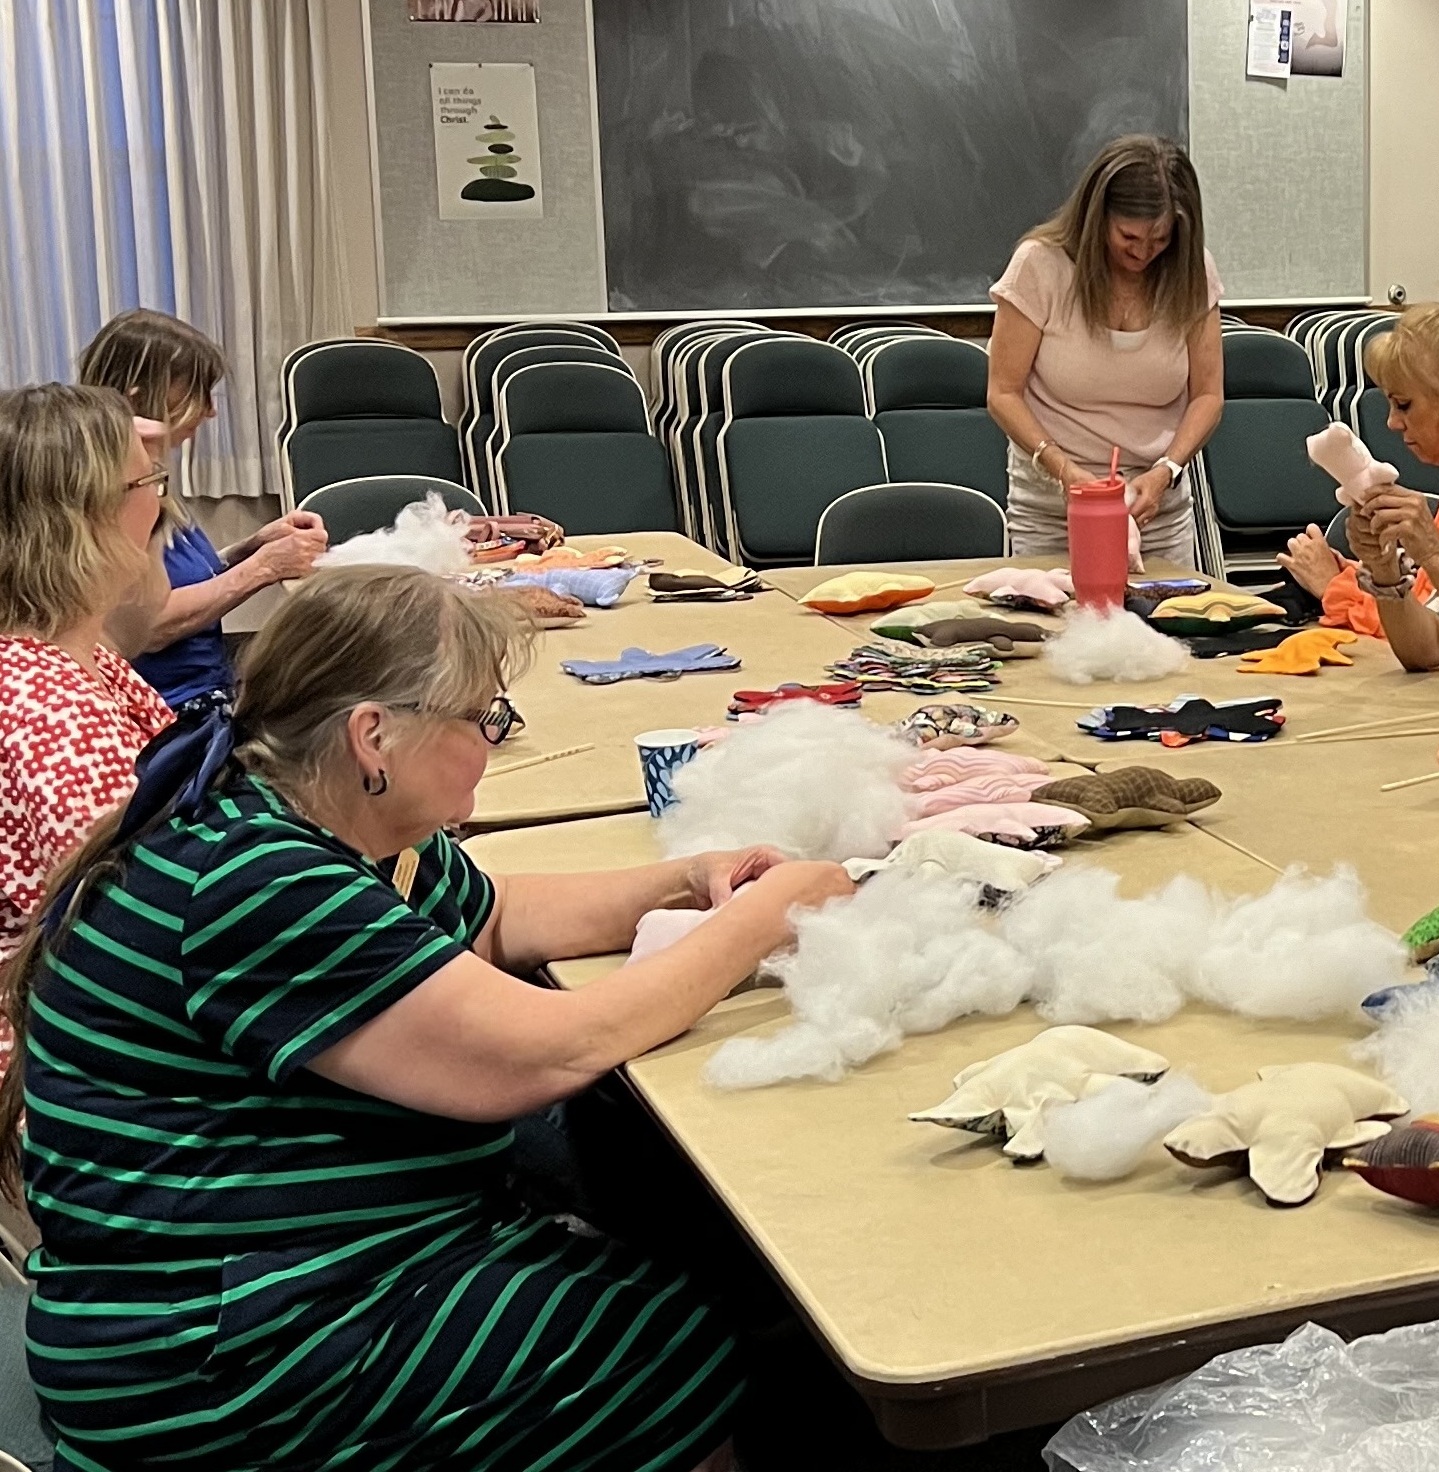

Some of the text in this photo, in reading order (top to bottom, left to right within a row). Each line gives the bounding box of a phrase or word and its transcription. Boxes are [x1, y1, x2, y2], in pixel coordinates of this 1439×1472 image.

[463, 87, 474, 95] do
[439, 97, 482, 106] all things
[440, 106, 478, 115] through
